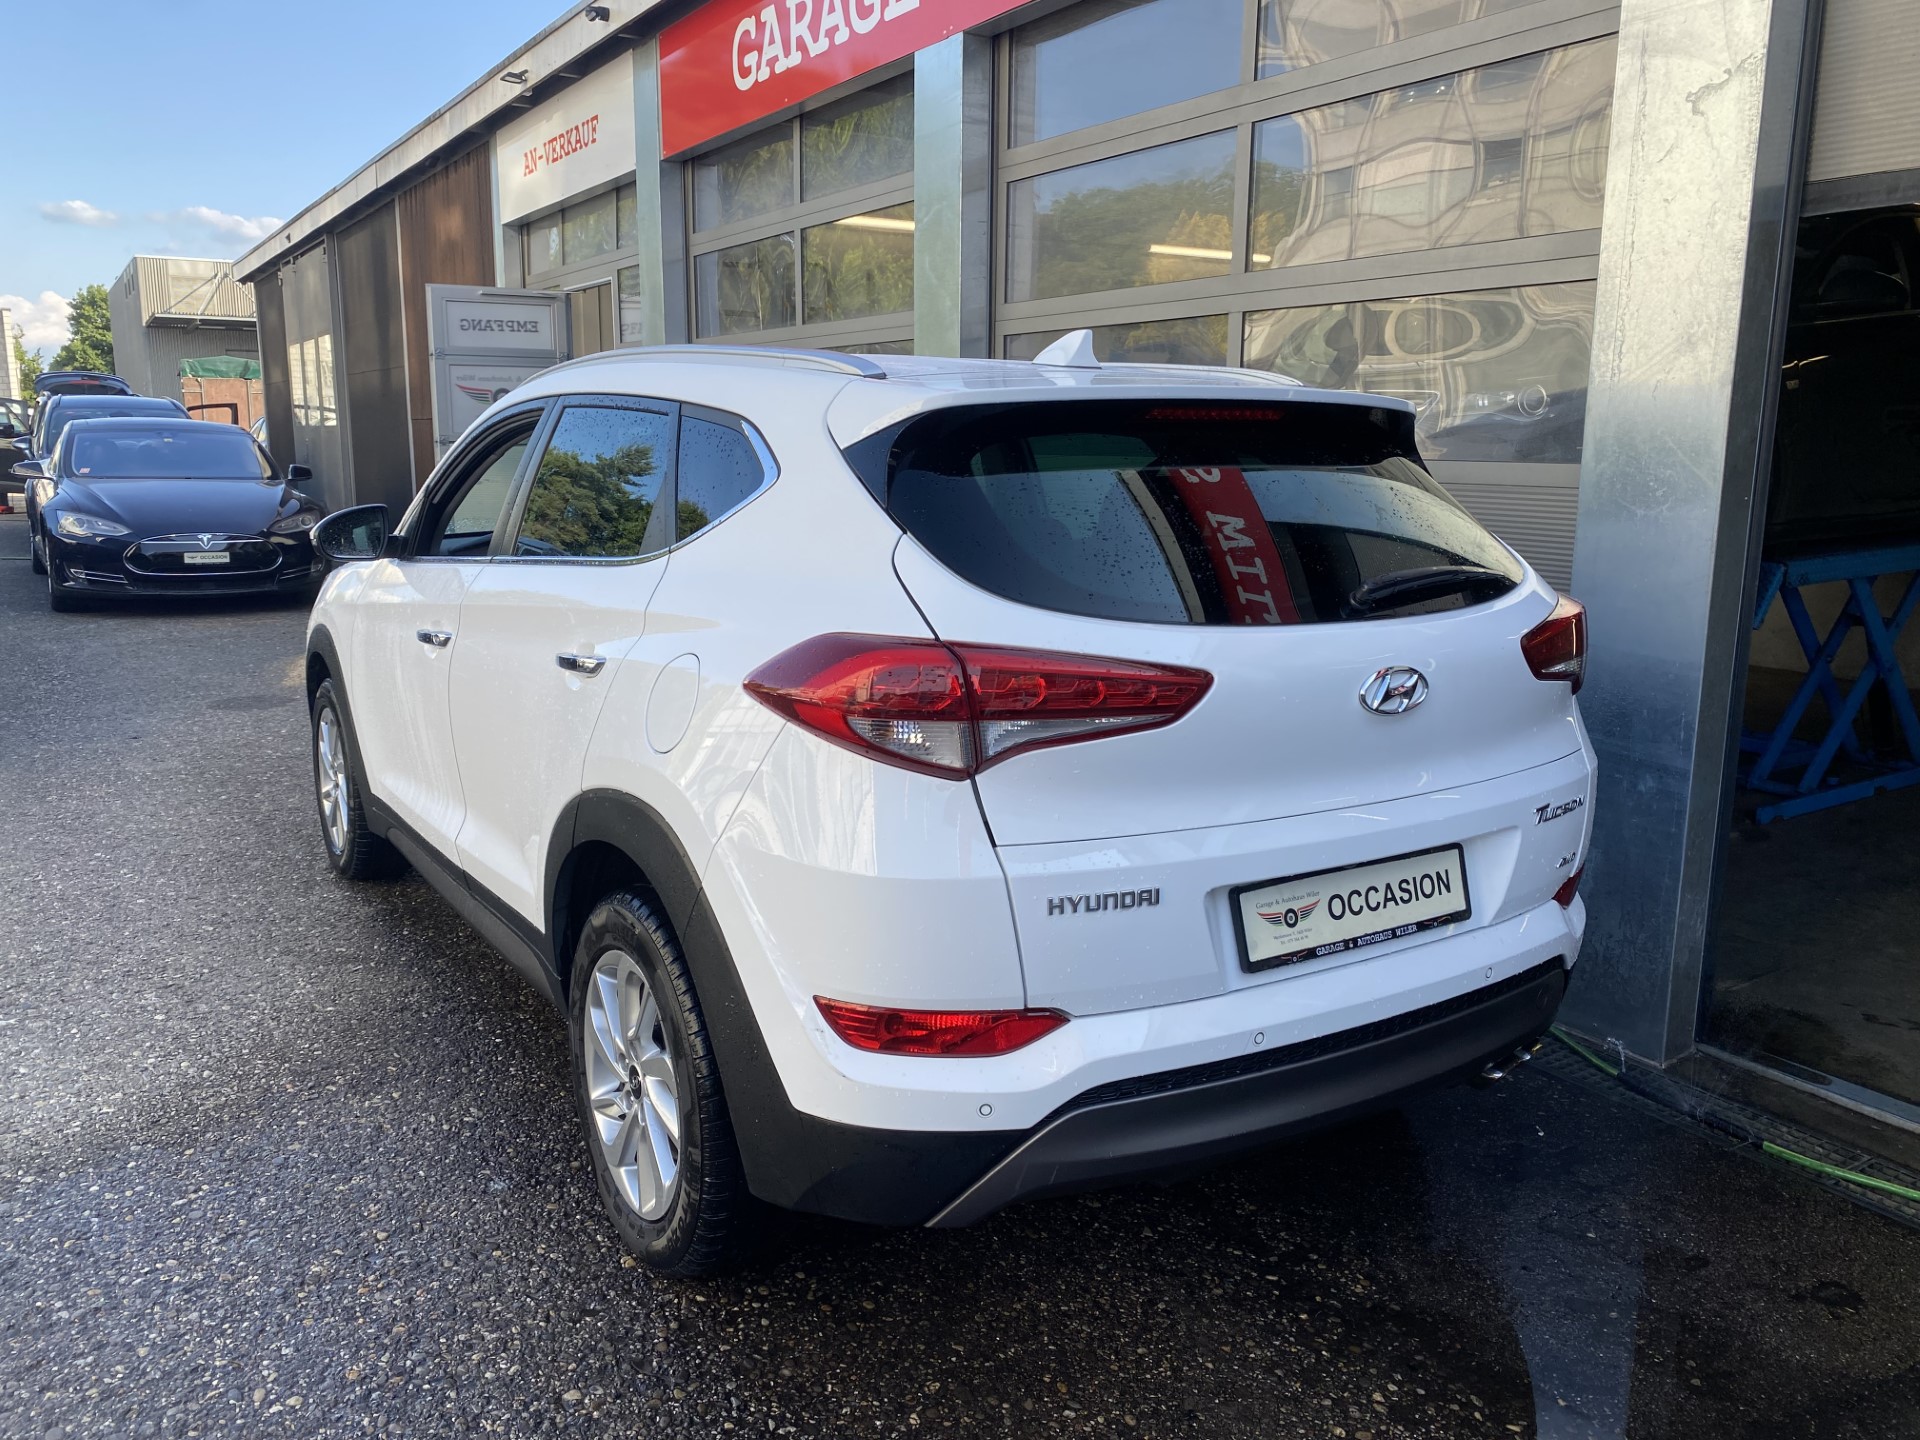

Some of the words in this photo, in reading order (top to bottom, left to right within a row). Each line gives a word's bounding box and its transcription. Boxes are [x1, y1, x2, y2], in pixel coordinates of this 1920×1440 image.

[523, 114, 599, 177] AN-VERKAUF
[1047, 887, 1160, 916] HYUNDAI
[1255, 900, 1274, 909] Garage
[1281, 894, 1305, 904] Autohaus
[1306, 891, 1320, 899] Wiler
[1328, 869, 1451, 921] OCCASION
[1316, 942, 1345, 956] GARAGE
[1357, 930, 1393, 946] AUTOHAUS
[1396, 924, 1418, 936] WILER
